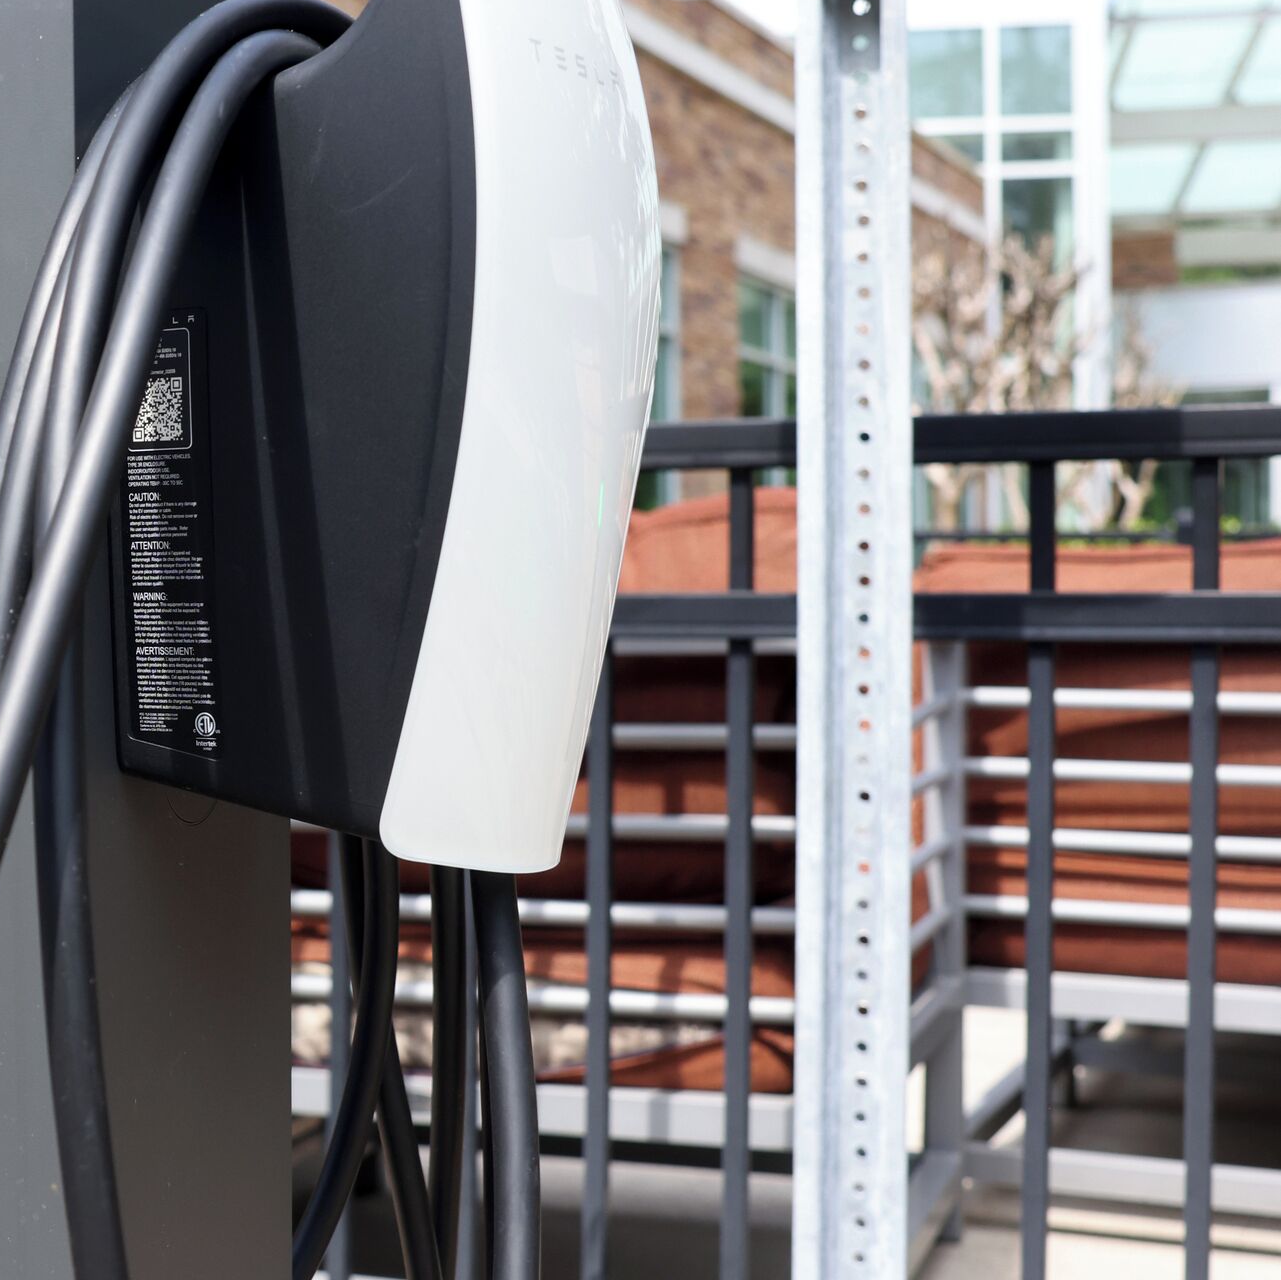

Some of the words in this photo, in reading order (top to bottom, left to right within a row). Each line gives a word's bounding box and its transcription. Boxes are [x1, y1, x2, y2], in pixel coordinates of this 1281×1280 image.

[128, 492, 162, 502] CAUTION:
[130, 540, 171, 550] ATTENTION:
[132, 592, 168, 601] WARNING:
[135, 646, 195, 656] AVERTISSEMENT:
